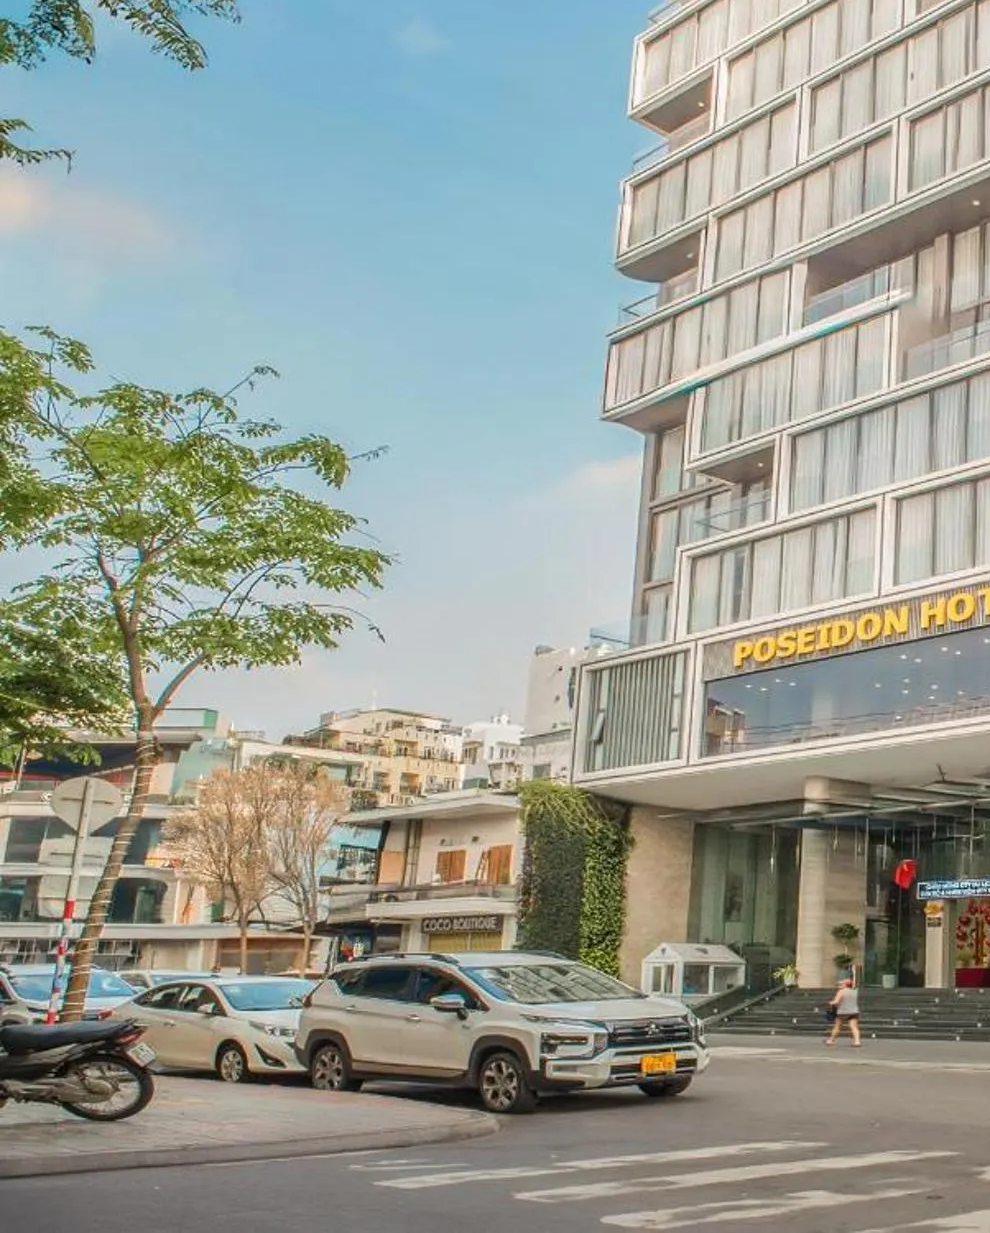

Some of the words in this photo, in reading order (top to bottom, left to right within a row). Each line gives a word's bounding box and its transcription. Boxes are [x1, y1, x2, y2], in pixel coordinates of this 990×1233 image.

[733, 606, 909, 668] POSEIDON
[423, 918, 452, 932] COCO
[453, 916, 498, 930] BOUTIQUE
